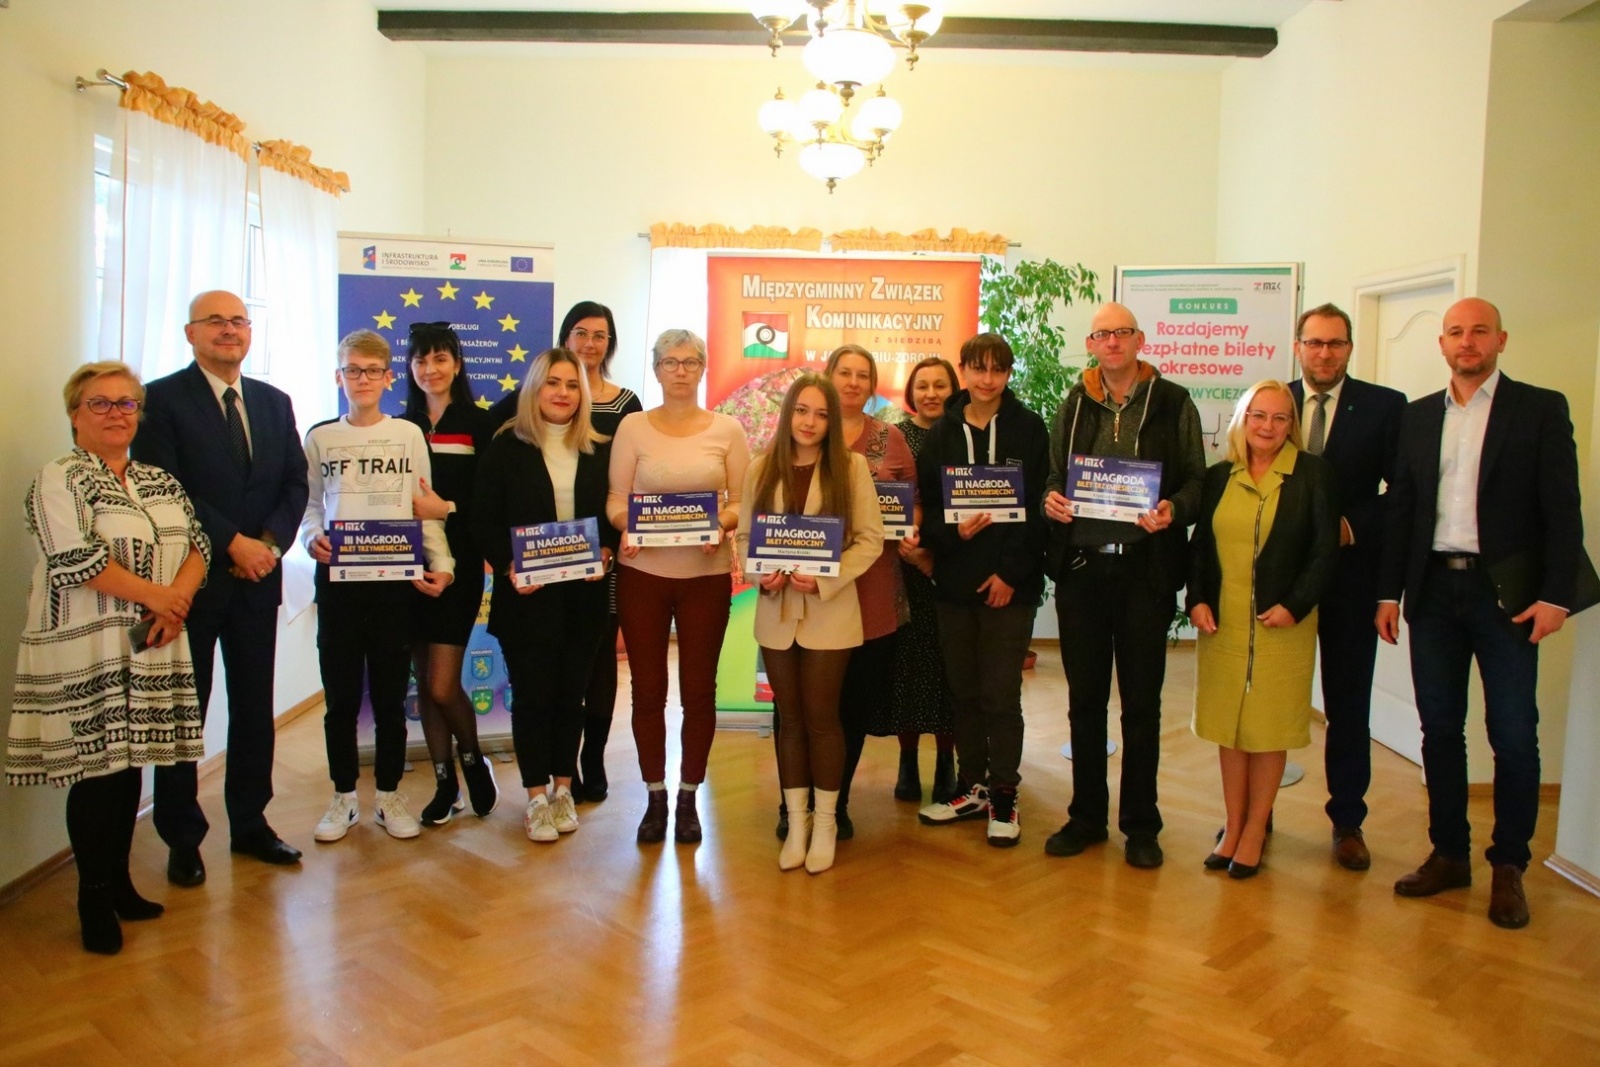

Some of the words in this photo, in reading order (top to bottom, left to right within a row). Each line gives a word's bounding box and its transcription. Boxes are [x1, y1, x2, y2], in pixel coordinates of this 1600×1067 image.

[743, 275, 864, 302] MIĘDZYGMINNY
[871, 277, 942, 304] ZWIĄZEK
[806, 305, 943, 331] KOMUNIKACYJNY
[1157, 322, 1248, 339] Rozdajemy
[888, 337, 942, 345] SIEDZIBĄ
[806, 350, 816, 362] W
[1141, 342, 1219, 358] ezpłatne
[1224, 342, 1275, 360] bilety
[1159, 361, 1243, 375] okresowe
[320, 460, 350, 477] OFF
[358, 458, 412, 474] TRAIL
[966, 480, 1011, 488] NAGRODA
[1082, 471, 1091, 480] III
[1093, 472, 1144, 485] NAGRODA
[654, 505, 703, 514] NAGRODA
[344, 536, 353, 544] III
[356, 535, 408, 544] NAGRODA
[766, 529, 772, 537] II
[774, 529, 826, 540] NAGRODA
[526, 541, 534, 550] III
[537, 535, 585, 548] NAGRODA
[540, 543, 590, 555] TRZYMIESIĘCZNY
[783, 538, 824, 547] PÓŁROCZNY
